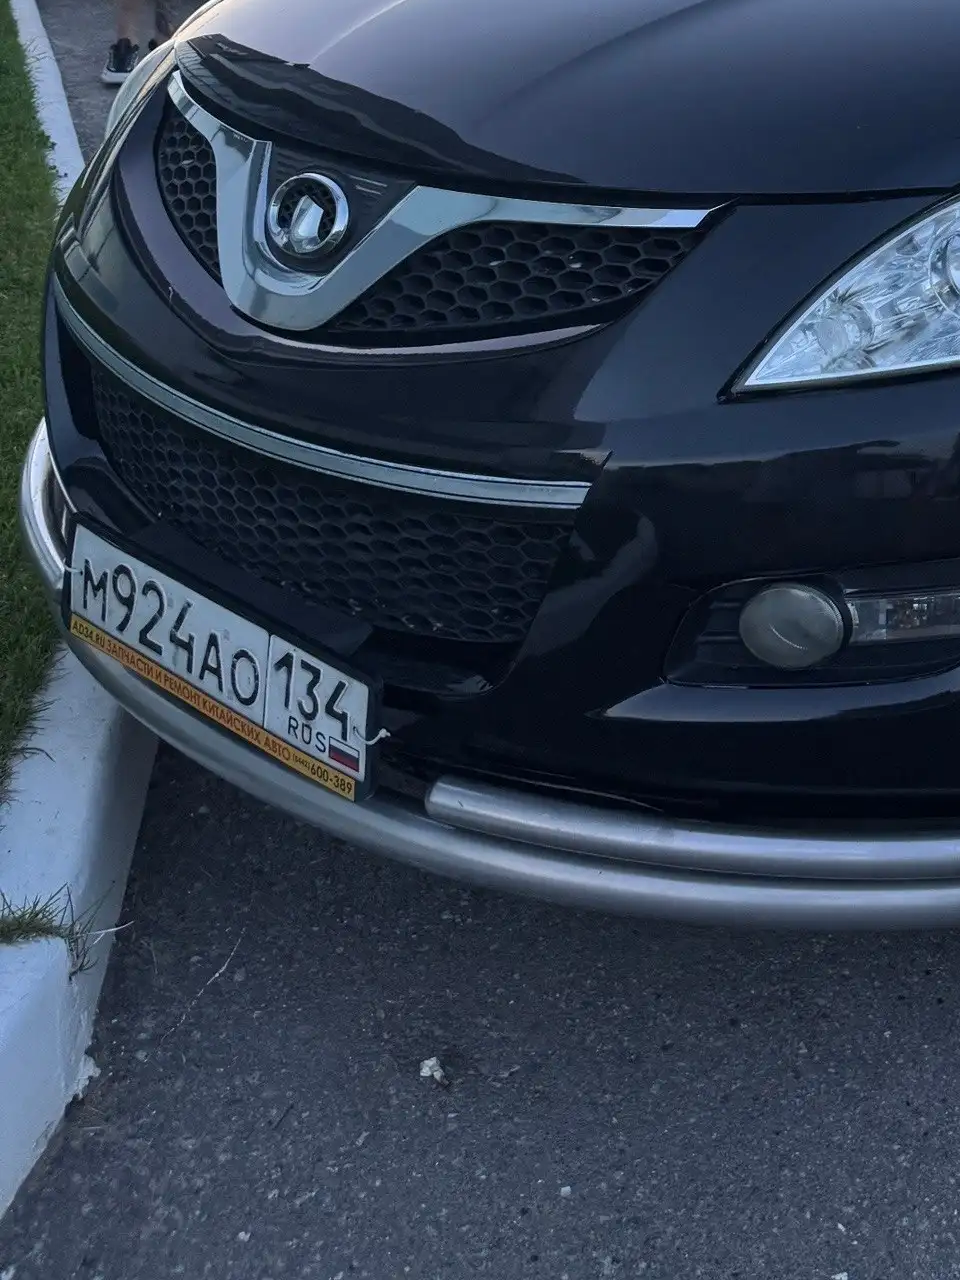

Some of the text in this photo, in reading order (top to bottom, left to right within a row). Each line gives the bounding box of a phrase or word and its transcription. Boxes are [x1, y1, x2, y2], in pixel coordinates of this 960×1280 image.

[106, 640, 154, 677] ЗАПЧАСТИ
[163, 672, 201, 707] РЕМОНТ
[202, 700, 261, 744] КИТАЙСКИХ
[263, 736, 291, 761] АВТО
[311, 763, 353, 794] 600-389
[274, 652, 348, 741] 134
[288, 716, 327, 753] RUS
